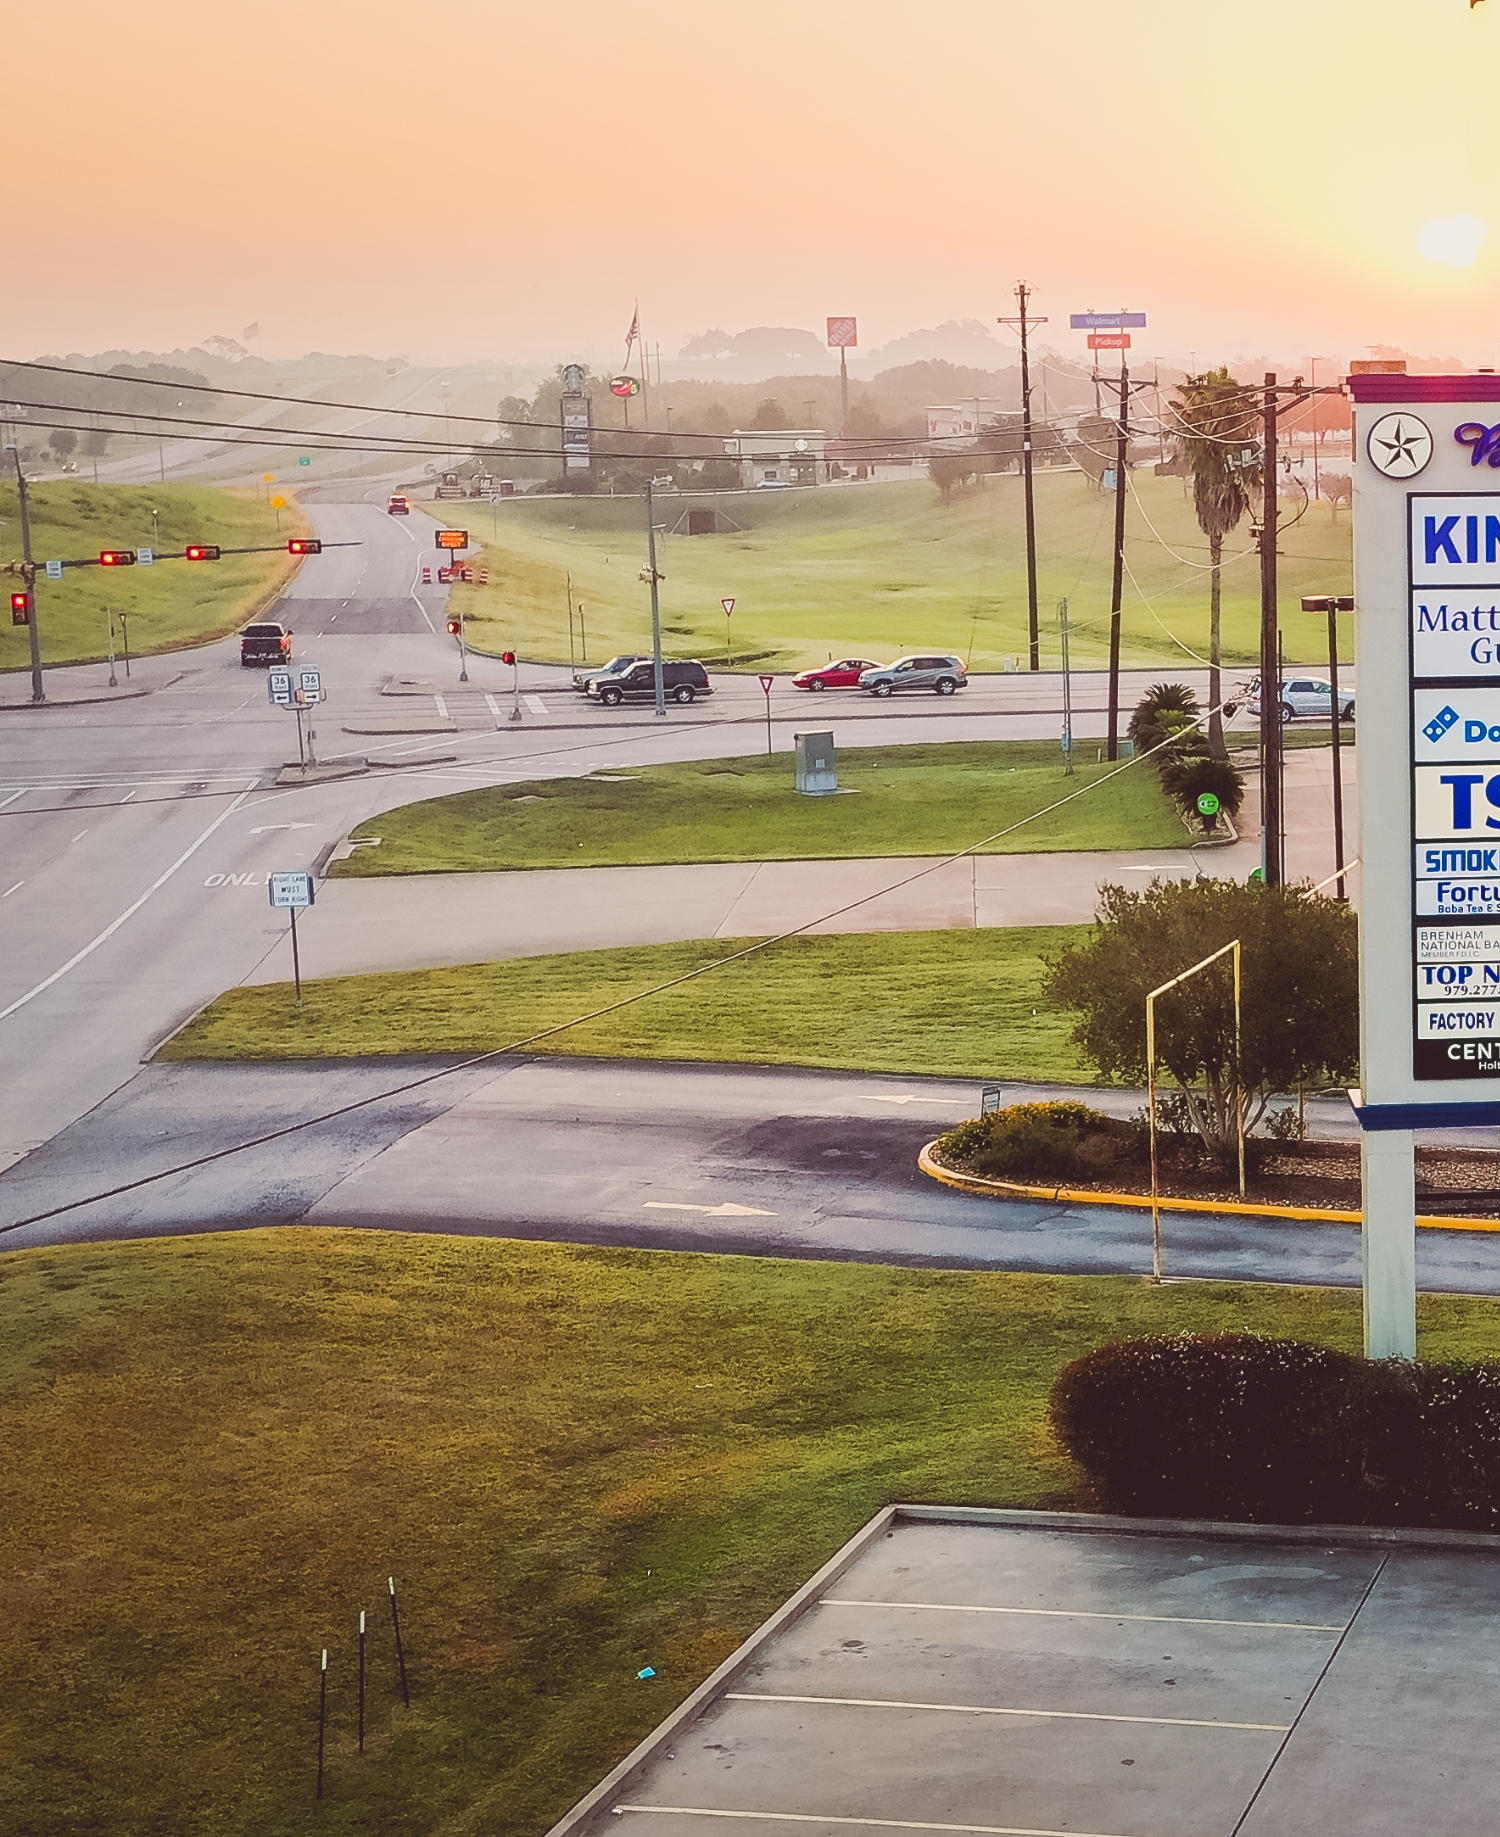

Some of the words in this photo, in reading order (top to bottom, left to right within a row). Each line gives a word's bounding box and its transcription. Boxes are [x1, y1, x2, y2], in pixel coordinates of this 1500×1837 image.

[1086, 317, 1120, 325] Walmart
[1095, 337, 1123, 347] Pickup
[1438, 904, 1464, 913] Boba
[1466, 903, 1483, 913] Tea
[1421, 930, 1484, 941] BRENHAM
[1421, 941, 1481, 950] NATIONAL
[1422, 965, 1473, 985] TOP
[1429, 1012, 1496, 1030] FACTORY
